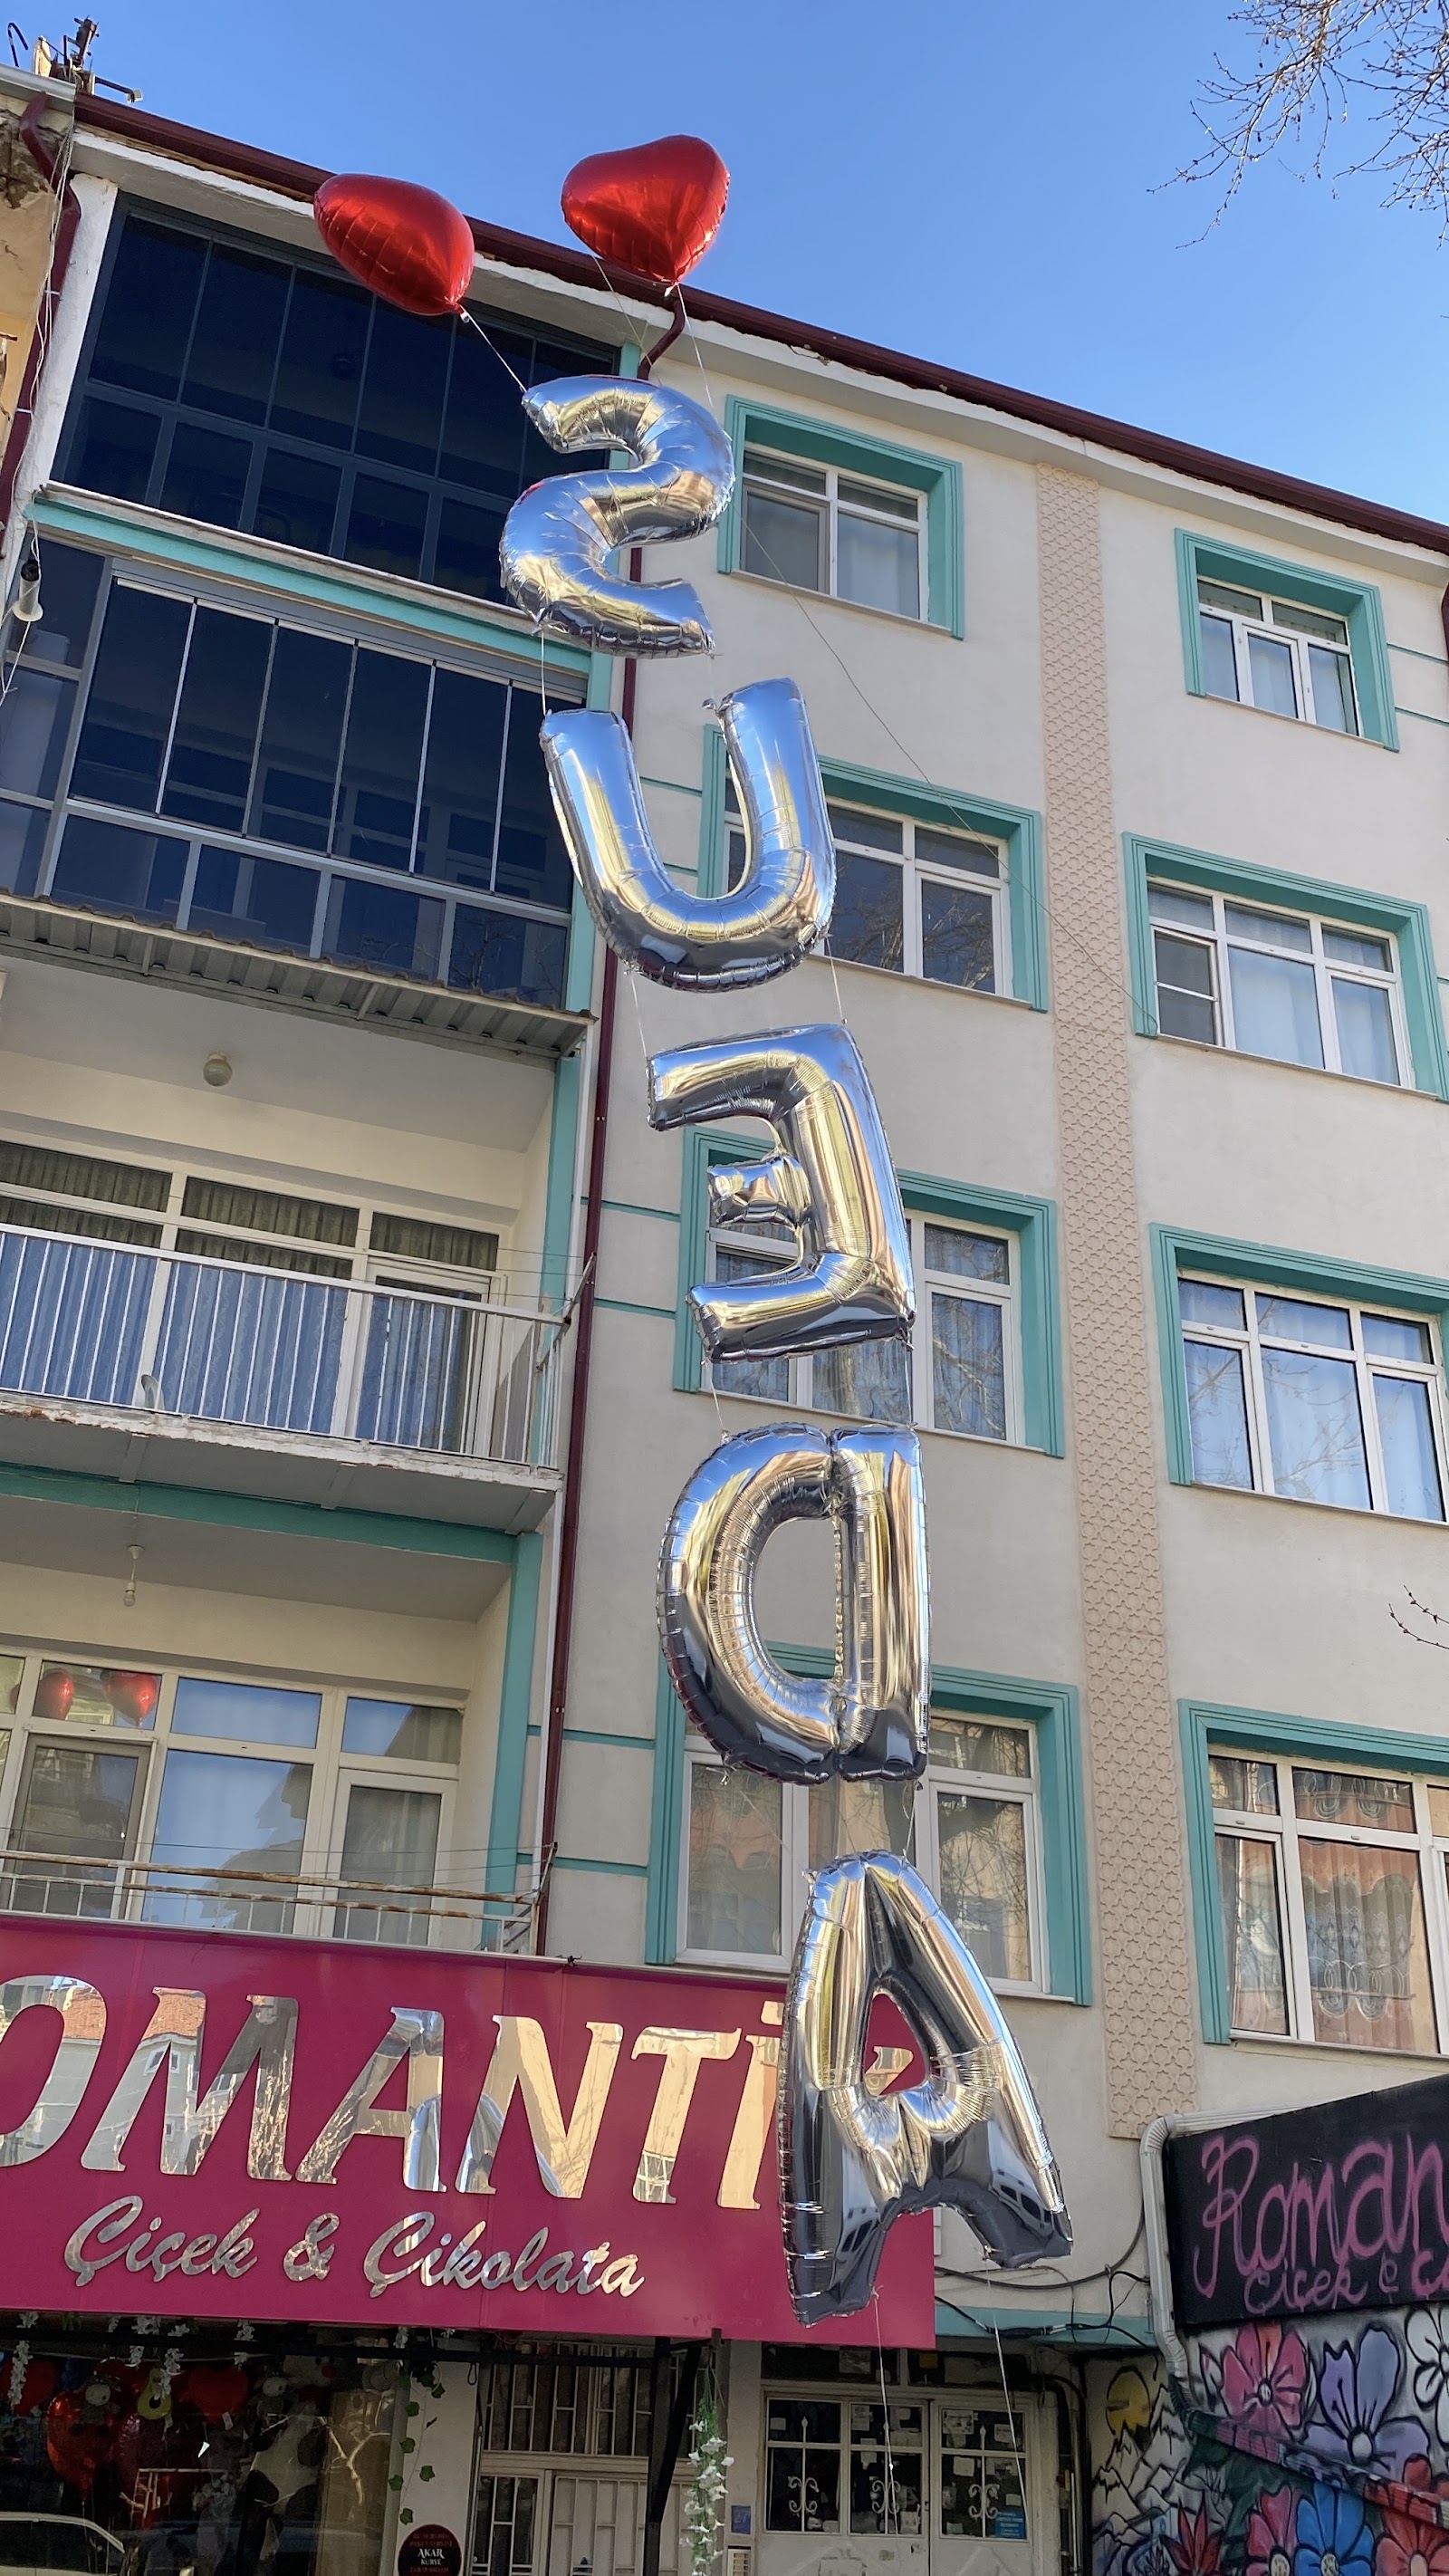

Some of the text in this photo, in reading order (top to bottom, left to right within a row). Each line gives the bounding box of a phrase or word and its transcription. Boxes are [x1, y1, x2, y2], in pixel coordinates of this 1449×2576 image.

[63, 2195, 646, 2299] Çiçek & Çikolata
[417, 2548, 446, 2560] AKAR
